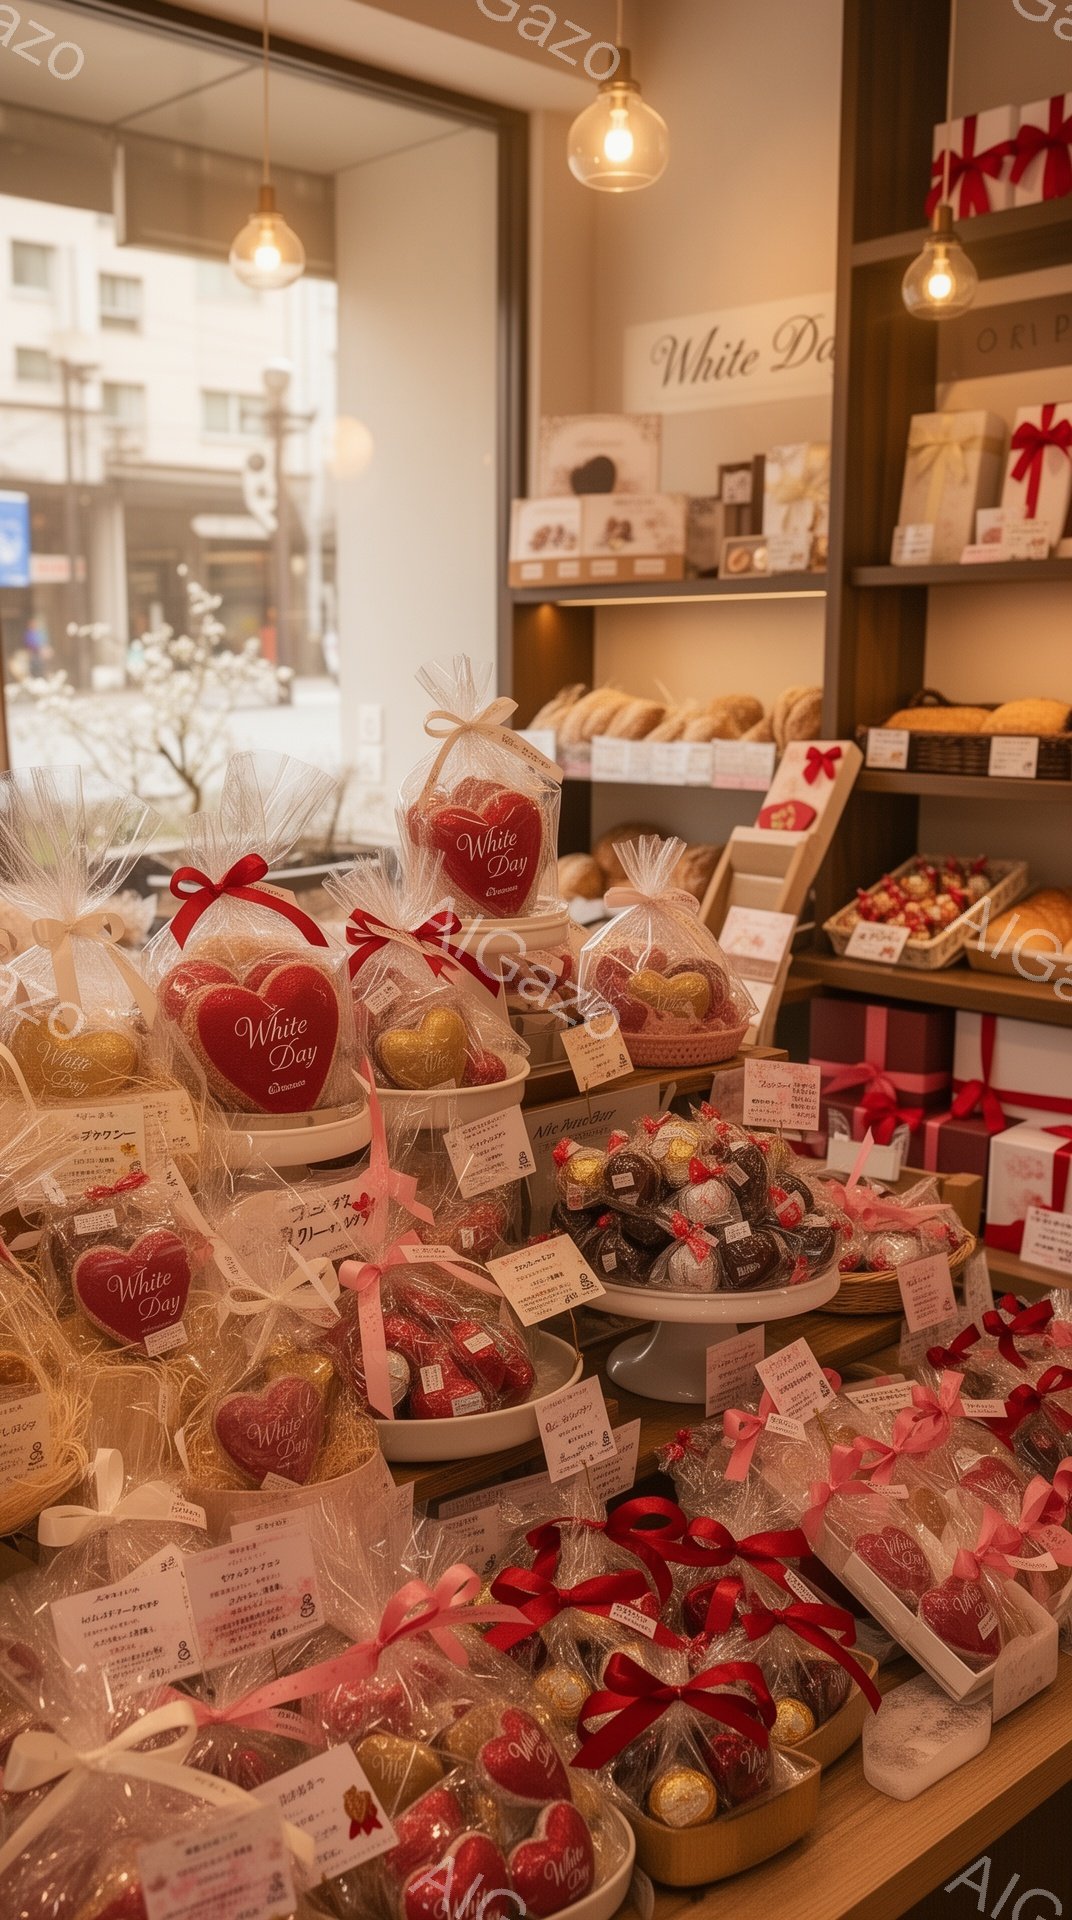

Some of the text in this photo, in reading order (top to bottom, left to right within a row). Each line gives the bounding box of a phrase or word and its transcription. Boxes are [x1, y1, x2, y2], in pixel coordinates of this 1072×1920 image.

[650, 313, 836, 389] White Da
[456, 825, 518, 862] White
[487, 847, 528, 878] Day
[234, 1007, 308, 1050] White
[268, 1036, 318, 1072] Day
[106, 1266, 172, 1303] White
[138, 1291, 180, 1321] Day
[246, 1414, 302, 1450] White
